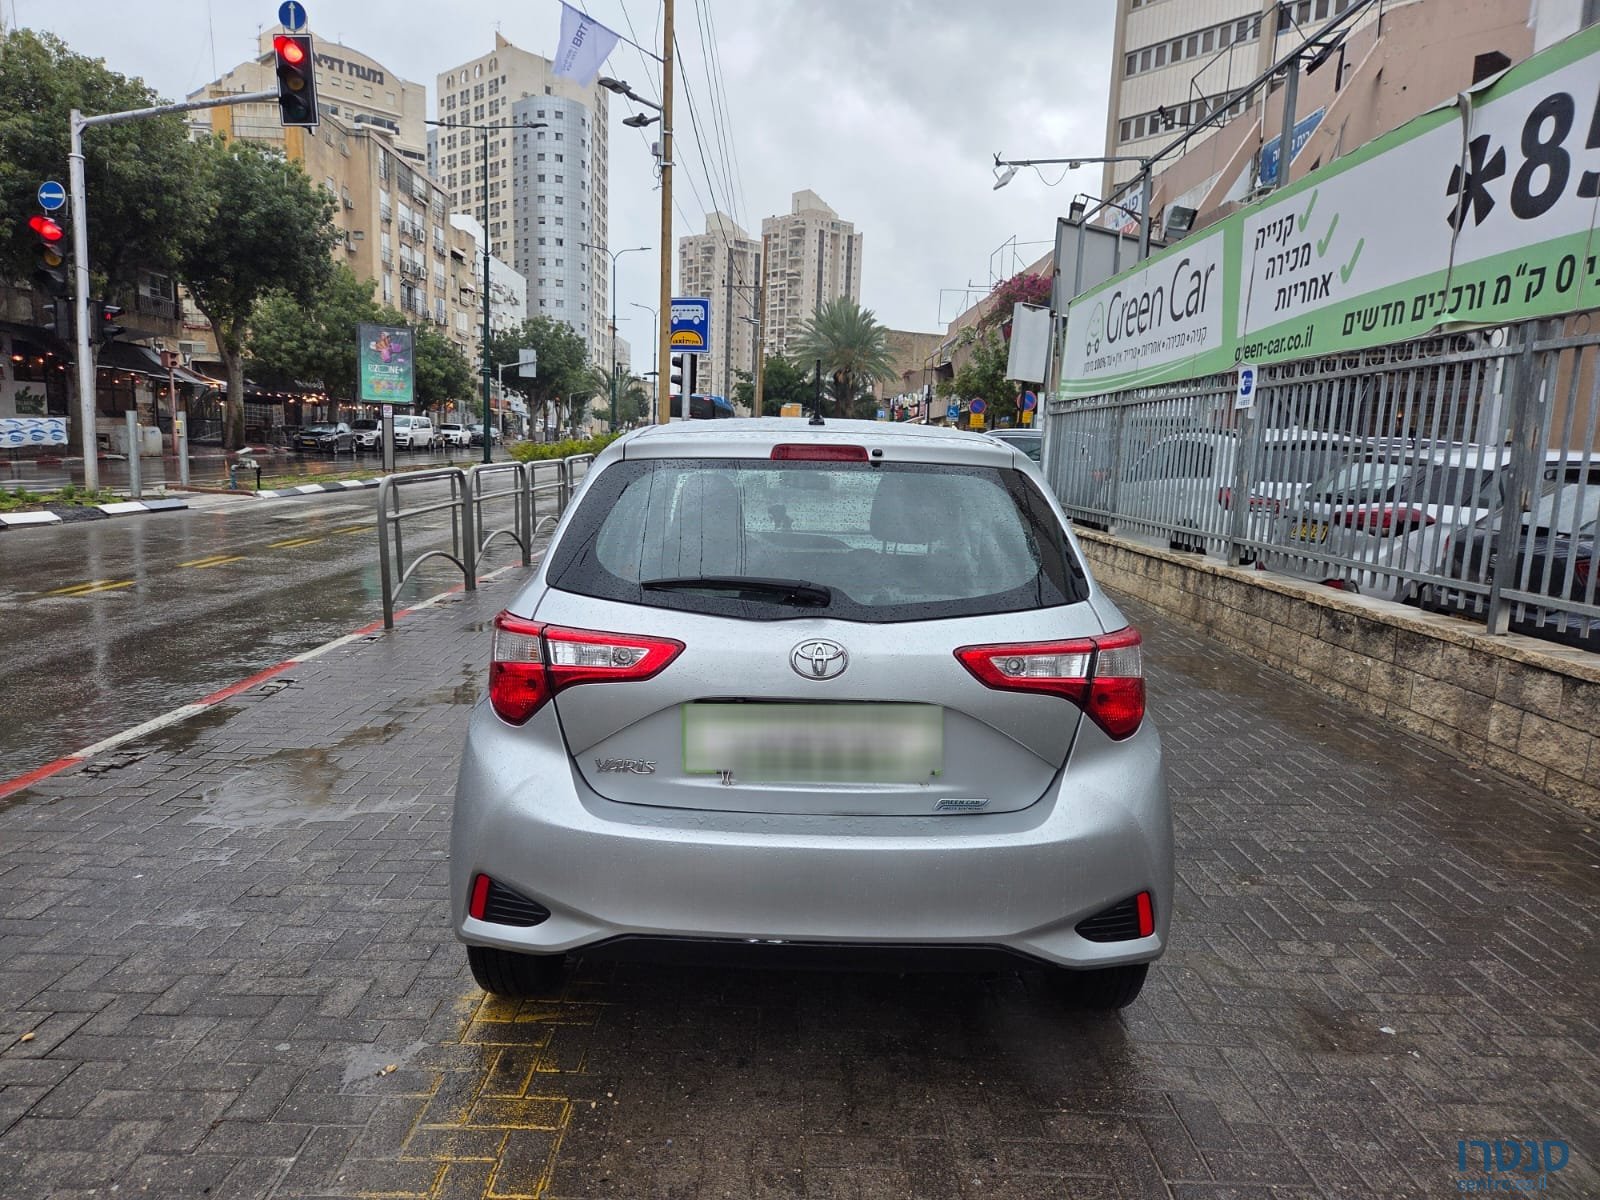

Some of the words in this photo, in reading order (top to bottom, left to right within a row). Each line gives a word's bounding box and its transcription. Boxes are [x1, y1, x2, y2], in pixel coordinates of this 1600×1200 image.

[313, 52, 345, 74] דניא
[1255, 213, 1295, 251] קנייה
[1265, 242, 1312, 280] מכירה
[1555, 254, 1576, 293] 0
[1106, 285, 1164, 344] Green
[1169, 257, 1216, 322] Car
[1274, 271, 1334, 312] אחריות
[1411, 281, 1486, 321] ורכבים
[1341, 299, 1406, 337] חדשים
[1235, 324, 1314, 361] geen-car.co.il
